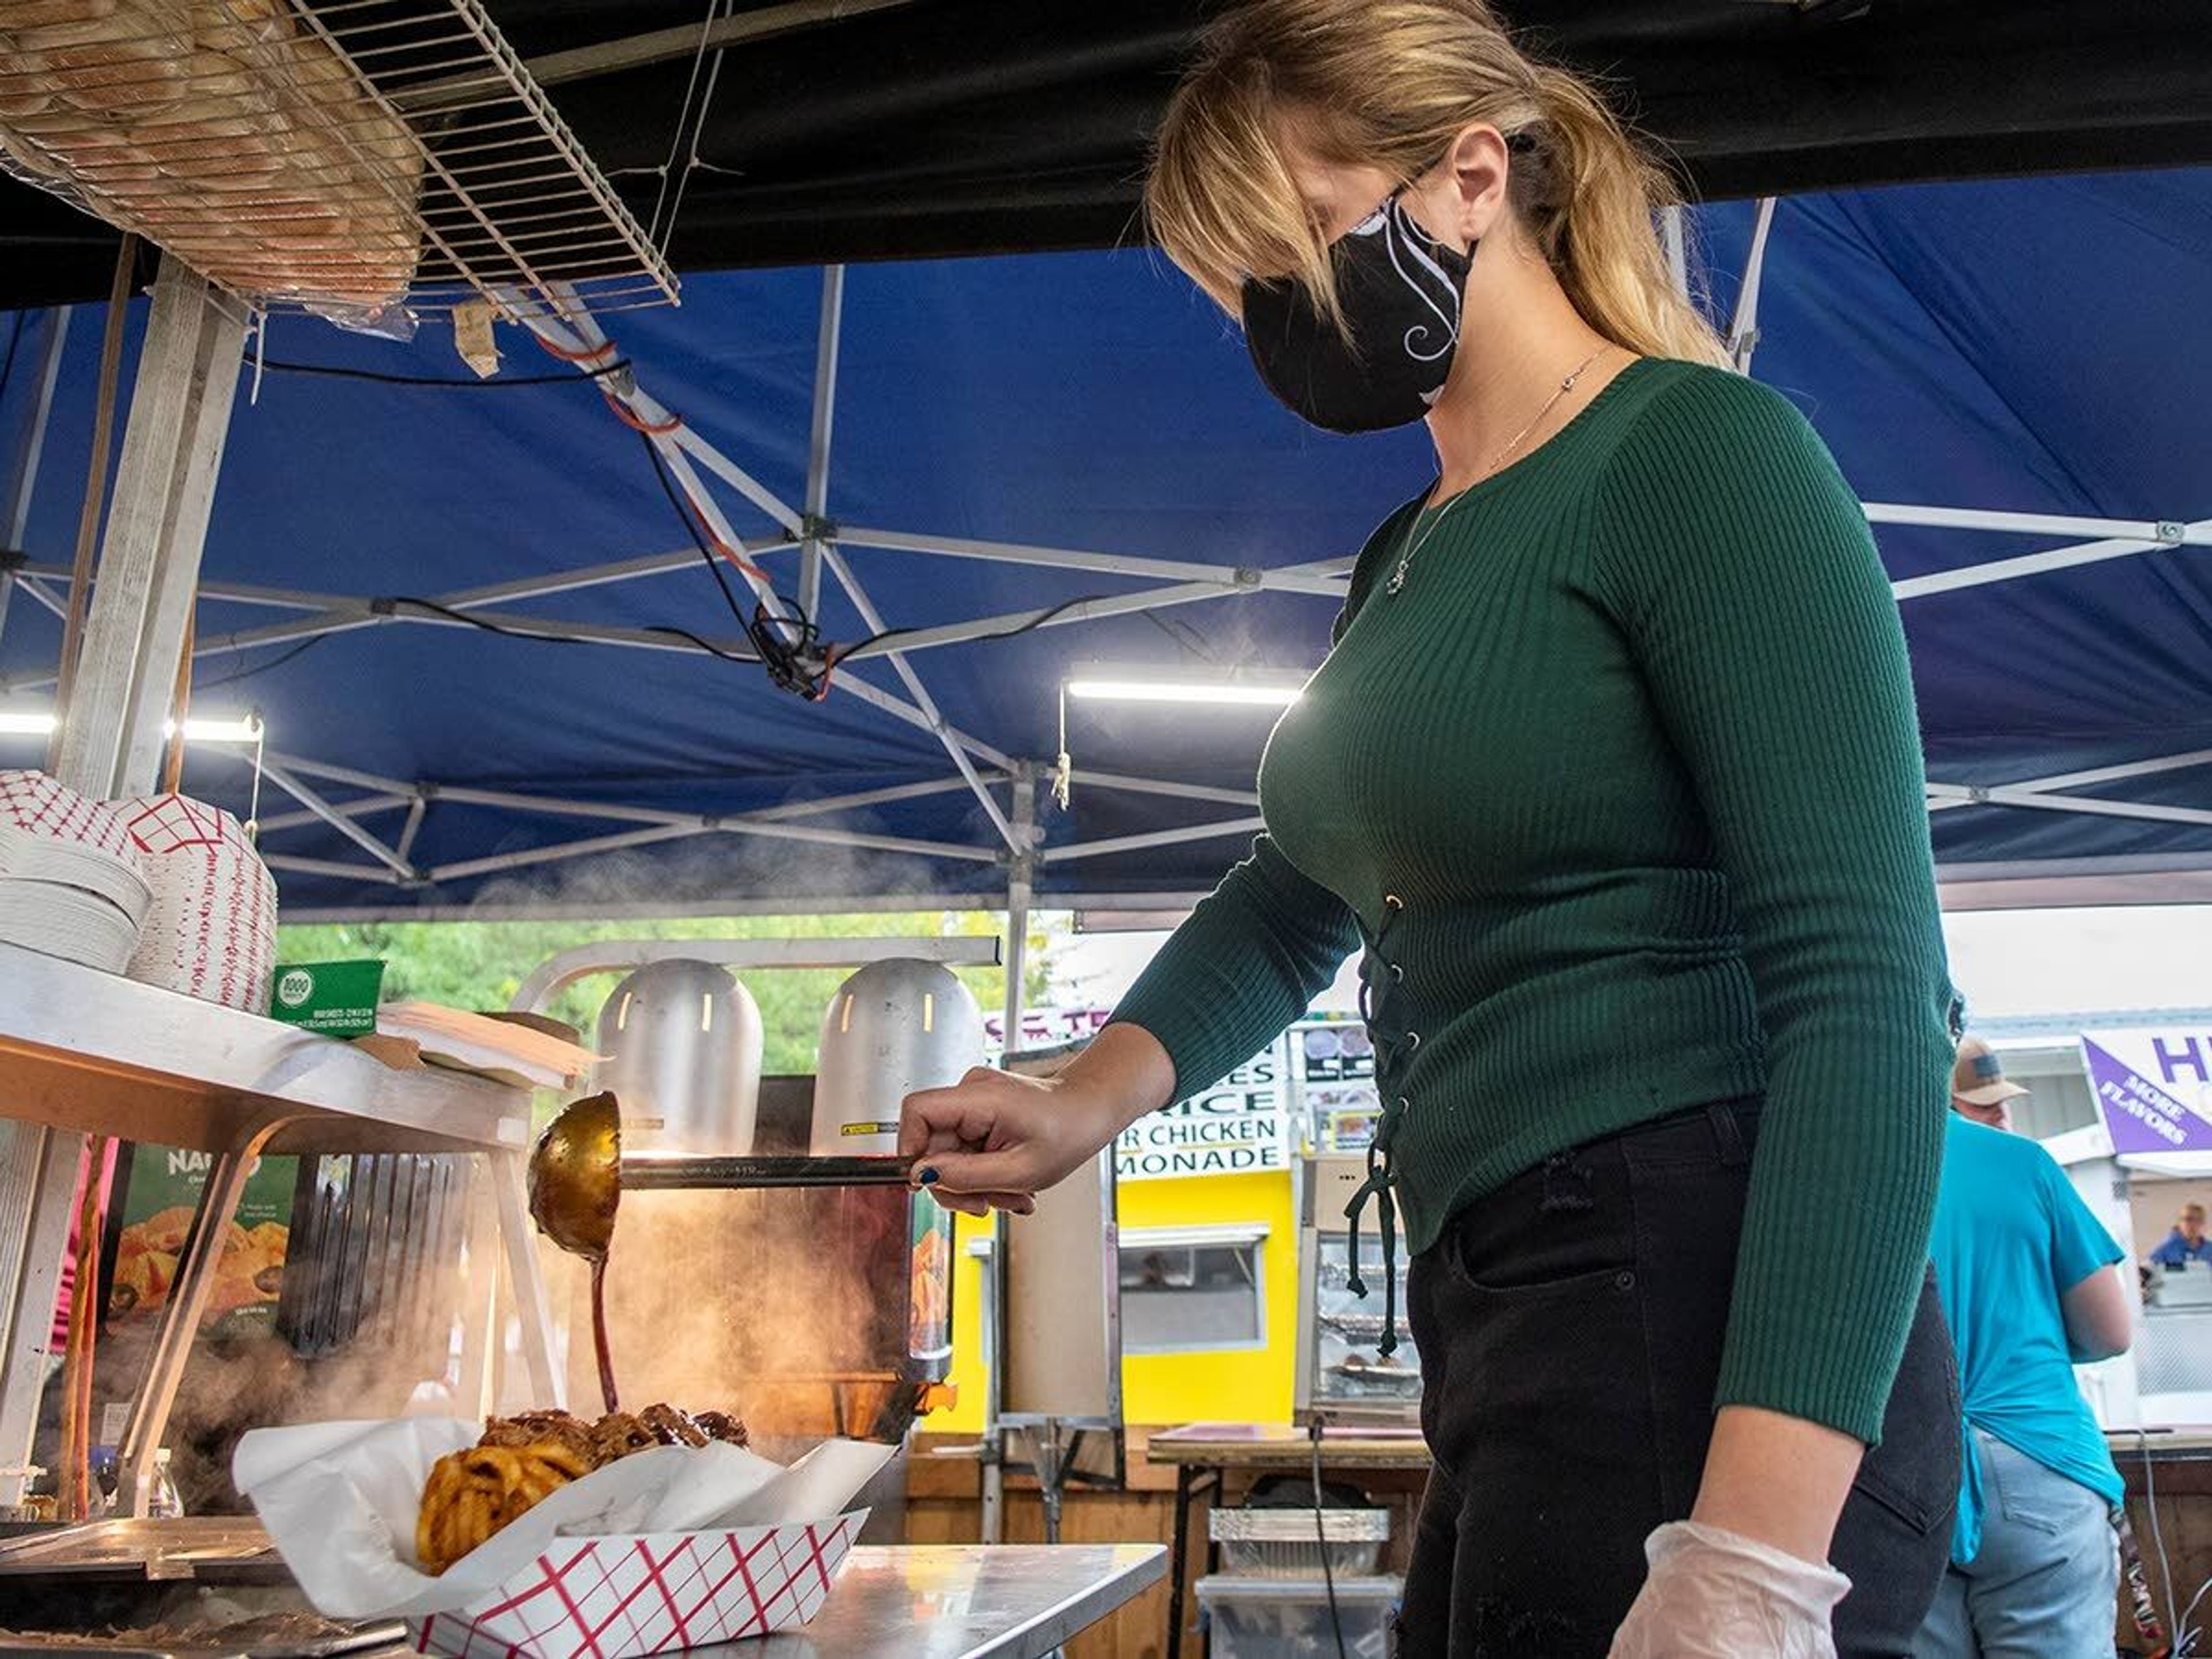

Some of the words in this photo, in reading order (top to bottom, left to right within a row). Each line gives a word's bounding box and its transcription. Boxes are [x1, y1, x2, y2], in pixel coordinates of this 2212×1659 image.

[1161, 1091, 1277, 1116] ICE
[2099, 1080, 2188, 1146] FLAVORS
[2123, 1074, 2186, 1123] MORE
[1149, 1118, 1276, 1146] CHICKEN
